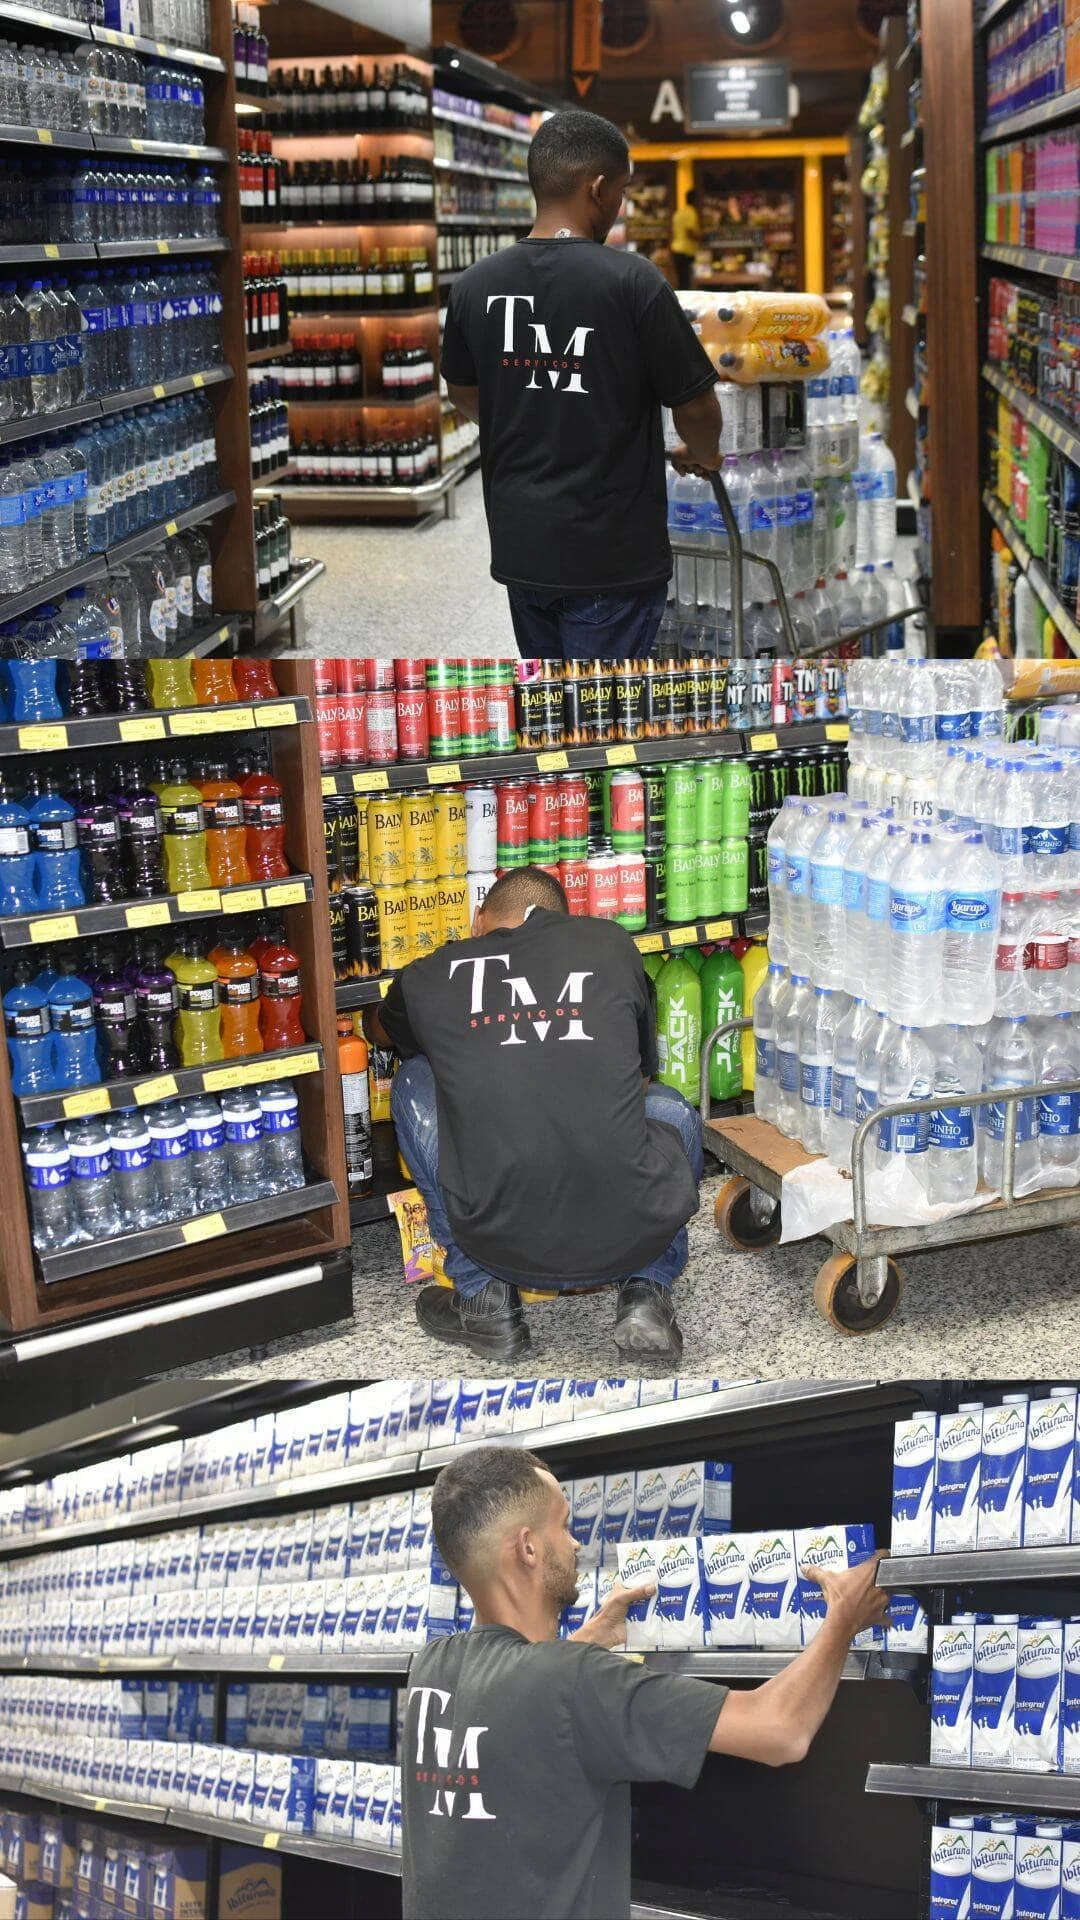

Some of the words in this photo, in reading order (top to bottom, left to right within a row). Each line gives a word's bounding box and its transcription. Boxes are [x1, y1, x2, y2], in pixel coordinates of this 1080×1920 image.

[589, 685, 612, 701] BALY
[617, 684, 642, 700] BALY
[398, 702, 424, 717] BALY
[461, 696, 487, 710] BALY
[338, 706, 364, 722] BALY
[560, 792, 587, 807] BALY
[913, 801, 934, 816] FYS
[620, 869, 645, 884] BALY
[409, 895, 439, 911] BALY
[438, 889, 466, 905] BALY
[470, 1008, 580, 1029] SERVIÇOS
[669, 996, 688, 1084] JACK
[982, 1420, 1025, 1447] Ibituruna
[1029, 1412, 1074, 1441] Ibituruna
[894, 1434, 934, 1458] Ibituruna
[939, 1427, 981, 1453] Ibituruna
[705, 1554, 745, 1576] Ibituruna
[748, 1552, 791, 1575] Ibituruna
[799, 1549, 843, 1566] ituruna
[620, 1558, 655, 1581] Ibituruna
[656, 1557, 695, 1580] Ibituruna
[934, 1642, 973, 1662] Ibituruna
[975, 1642, 1016, 1664] Ibituruna
[1017, 1646, 1060, 1668] Ibituruna
[932, 1847, 970, 1864] Ibituruna
[972, 1852, 1013, 1870] Ibituruna
[1016, 1857, 1059, 1876] Ibituruna
